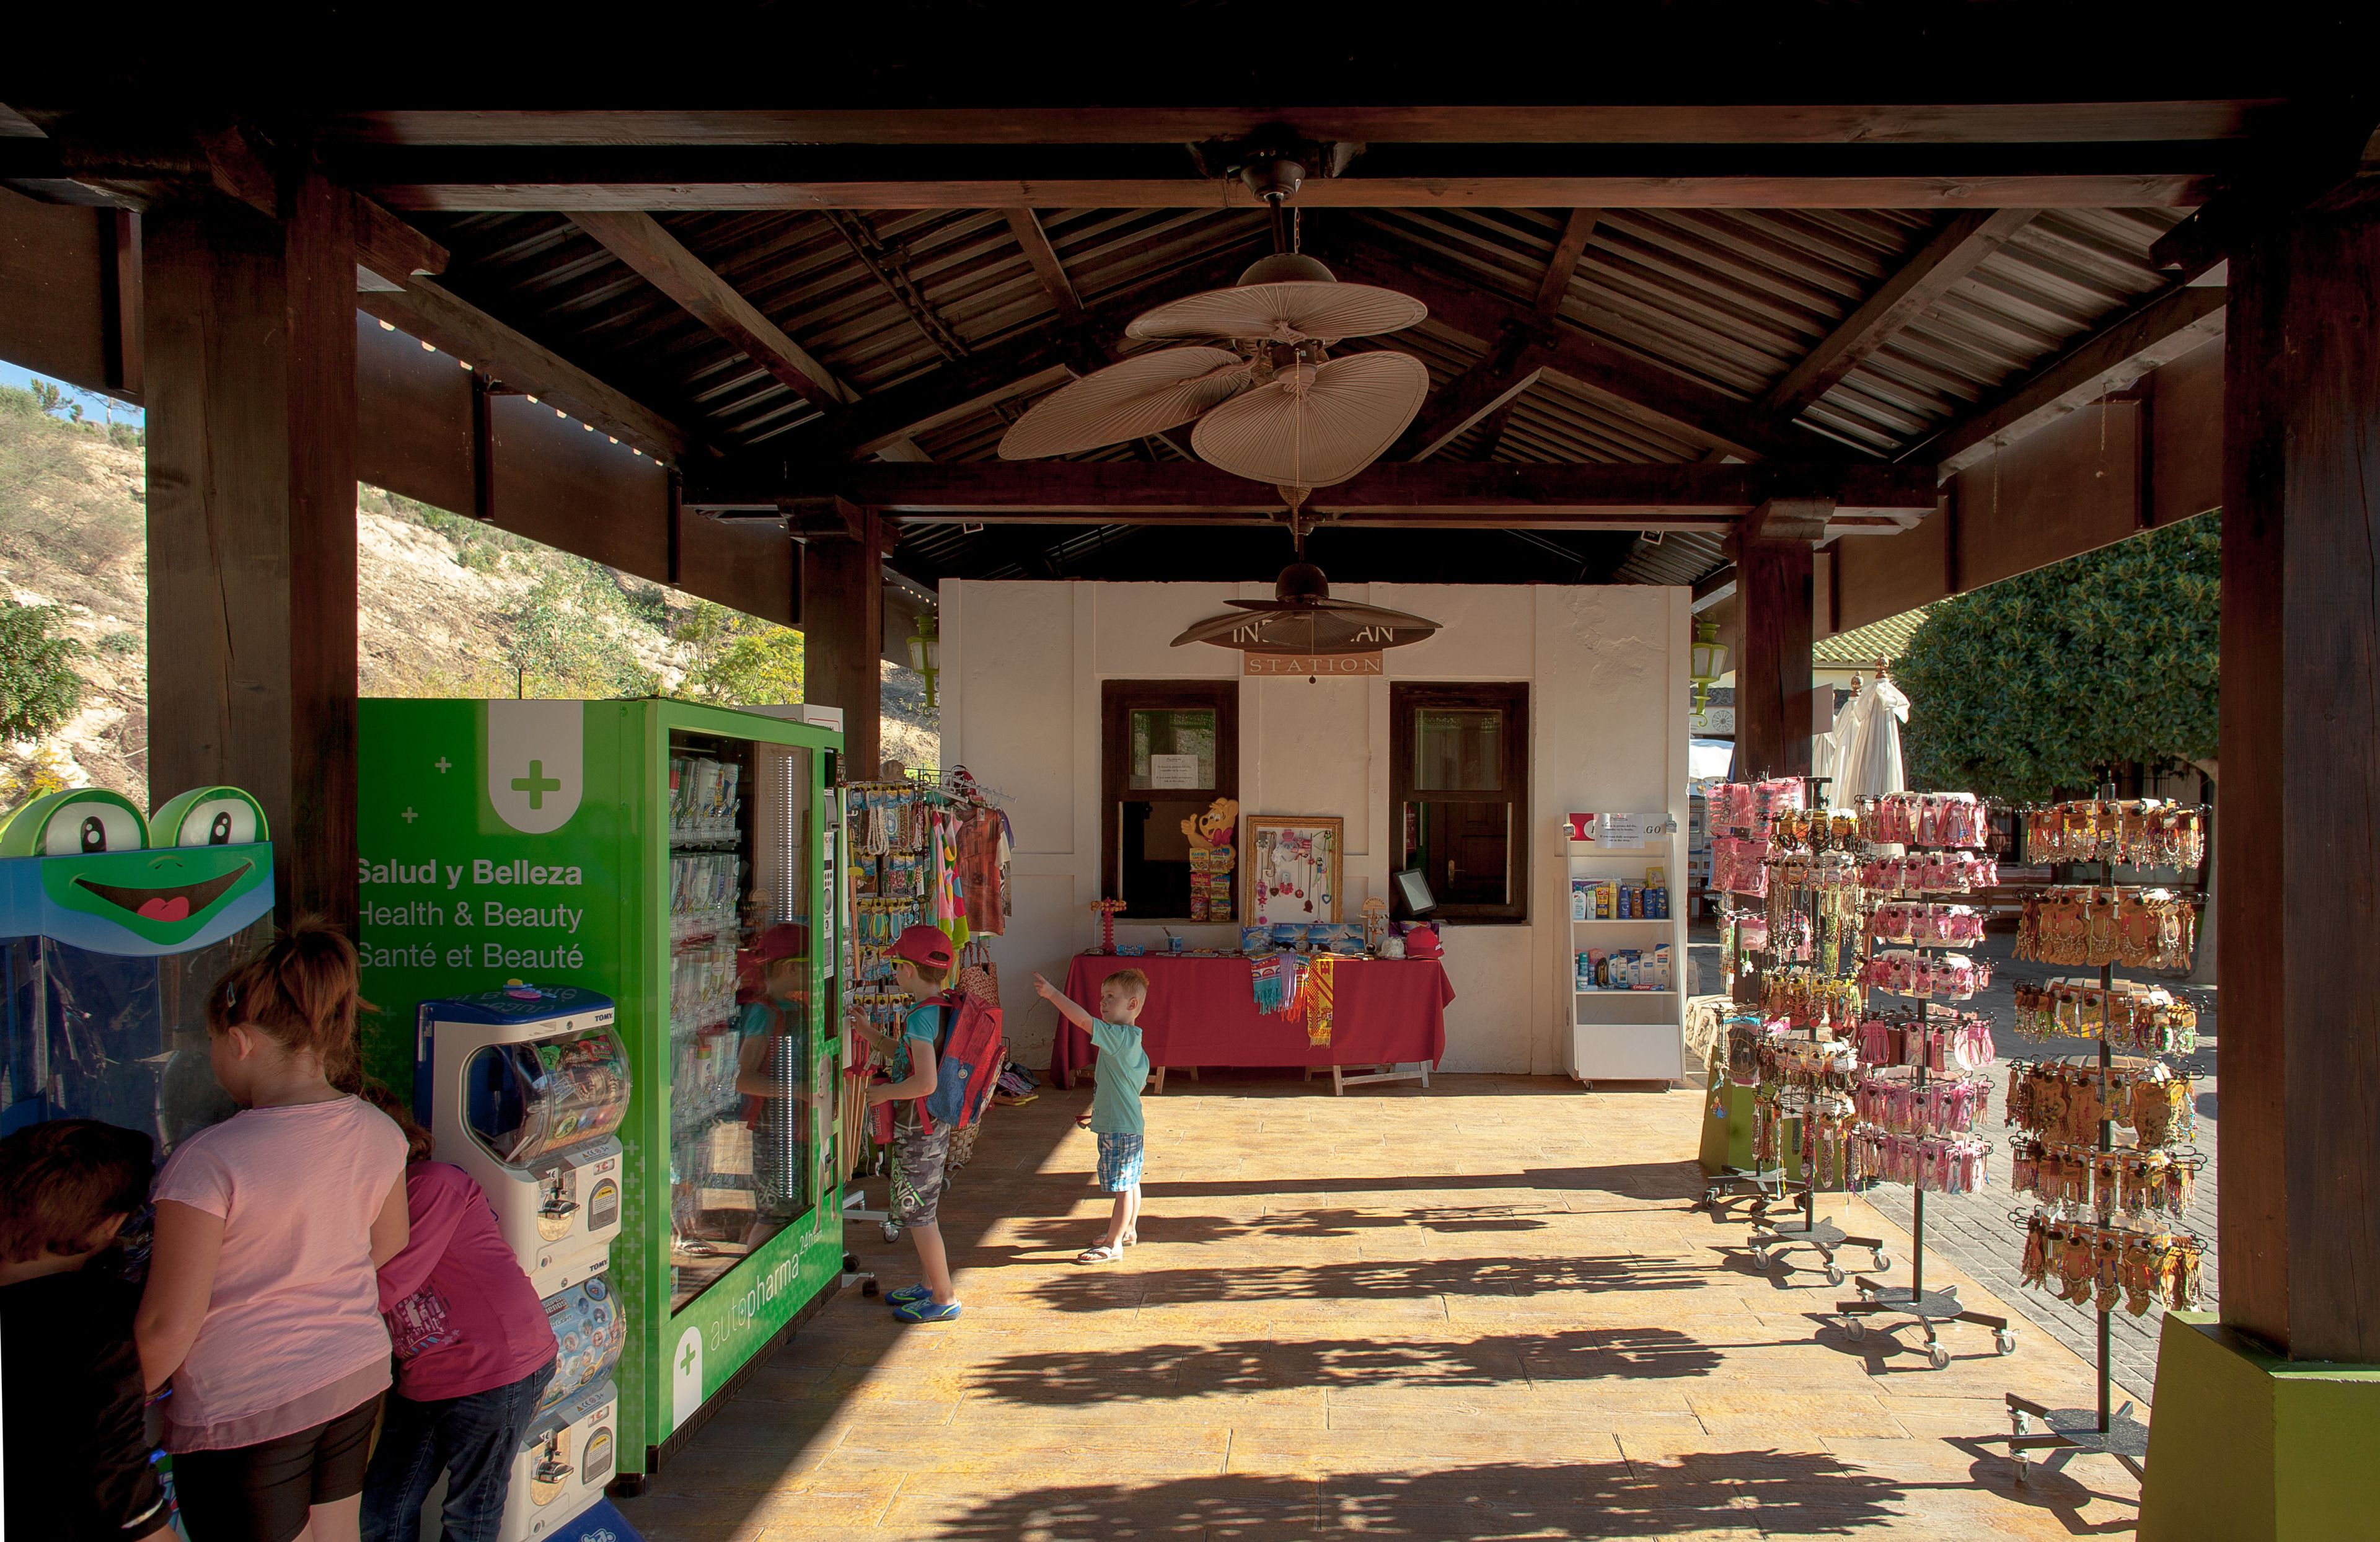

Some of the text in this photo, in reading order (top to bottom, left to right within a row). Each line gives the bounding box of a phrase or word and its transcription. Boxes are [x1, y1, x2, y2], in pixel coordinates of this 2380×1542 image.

[1250, 659, 1381, 672] STATION
[359, 858, 583, 890] Salud y Belleza
[359, 901, 583, 933] Health & Beauty
[359, 942, 584, 969] Santé et Beauté
[594, 1013, 613, 1021] TOMY
[596, 1161, 609, 1171] 1€
[589, 1258, 608, 1272] TOMY
[711, 1253, 799, 1351] autopharma
[590, 1410, 603, 1422] 1€
